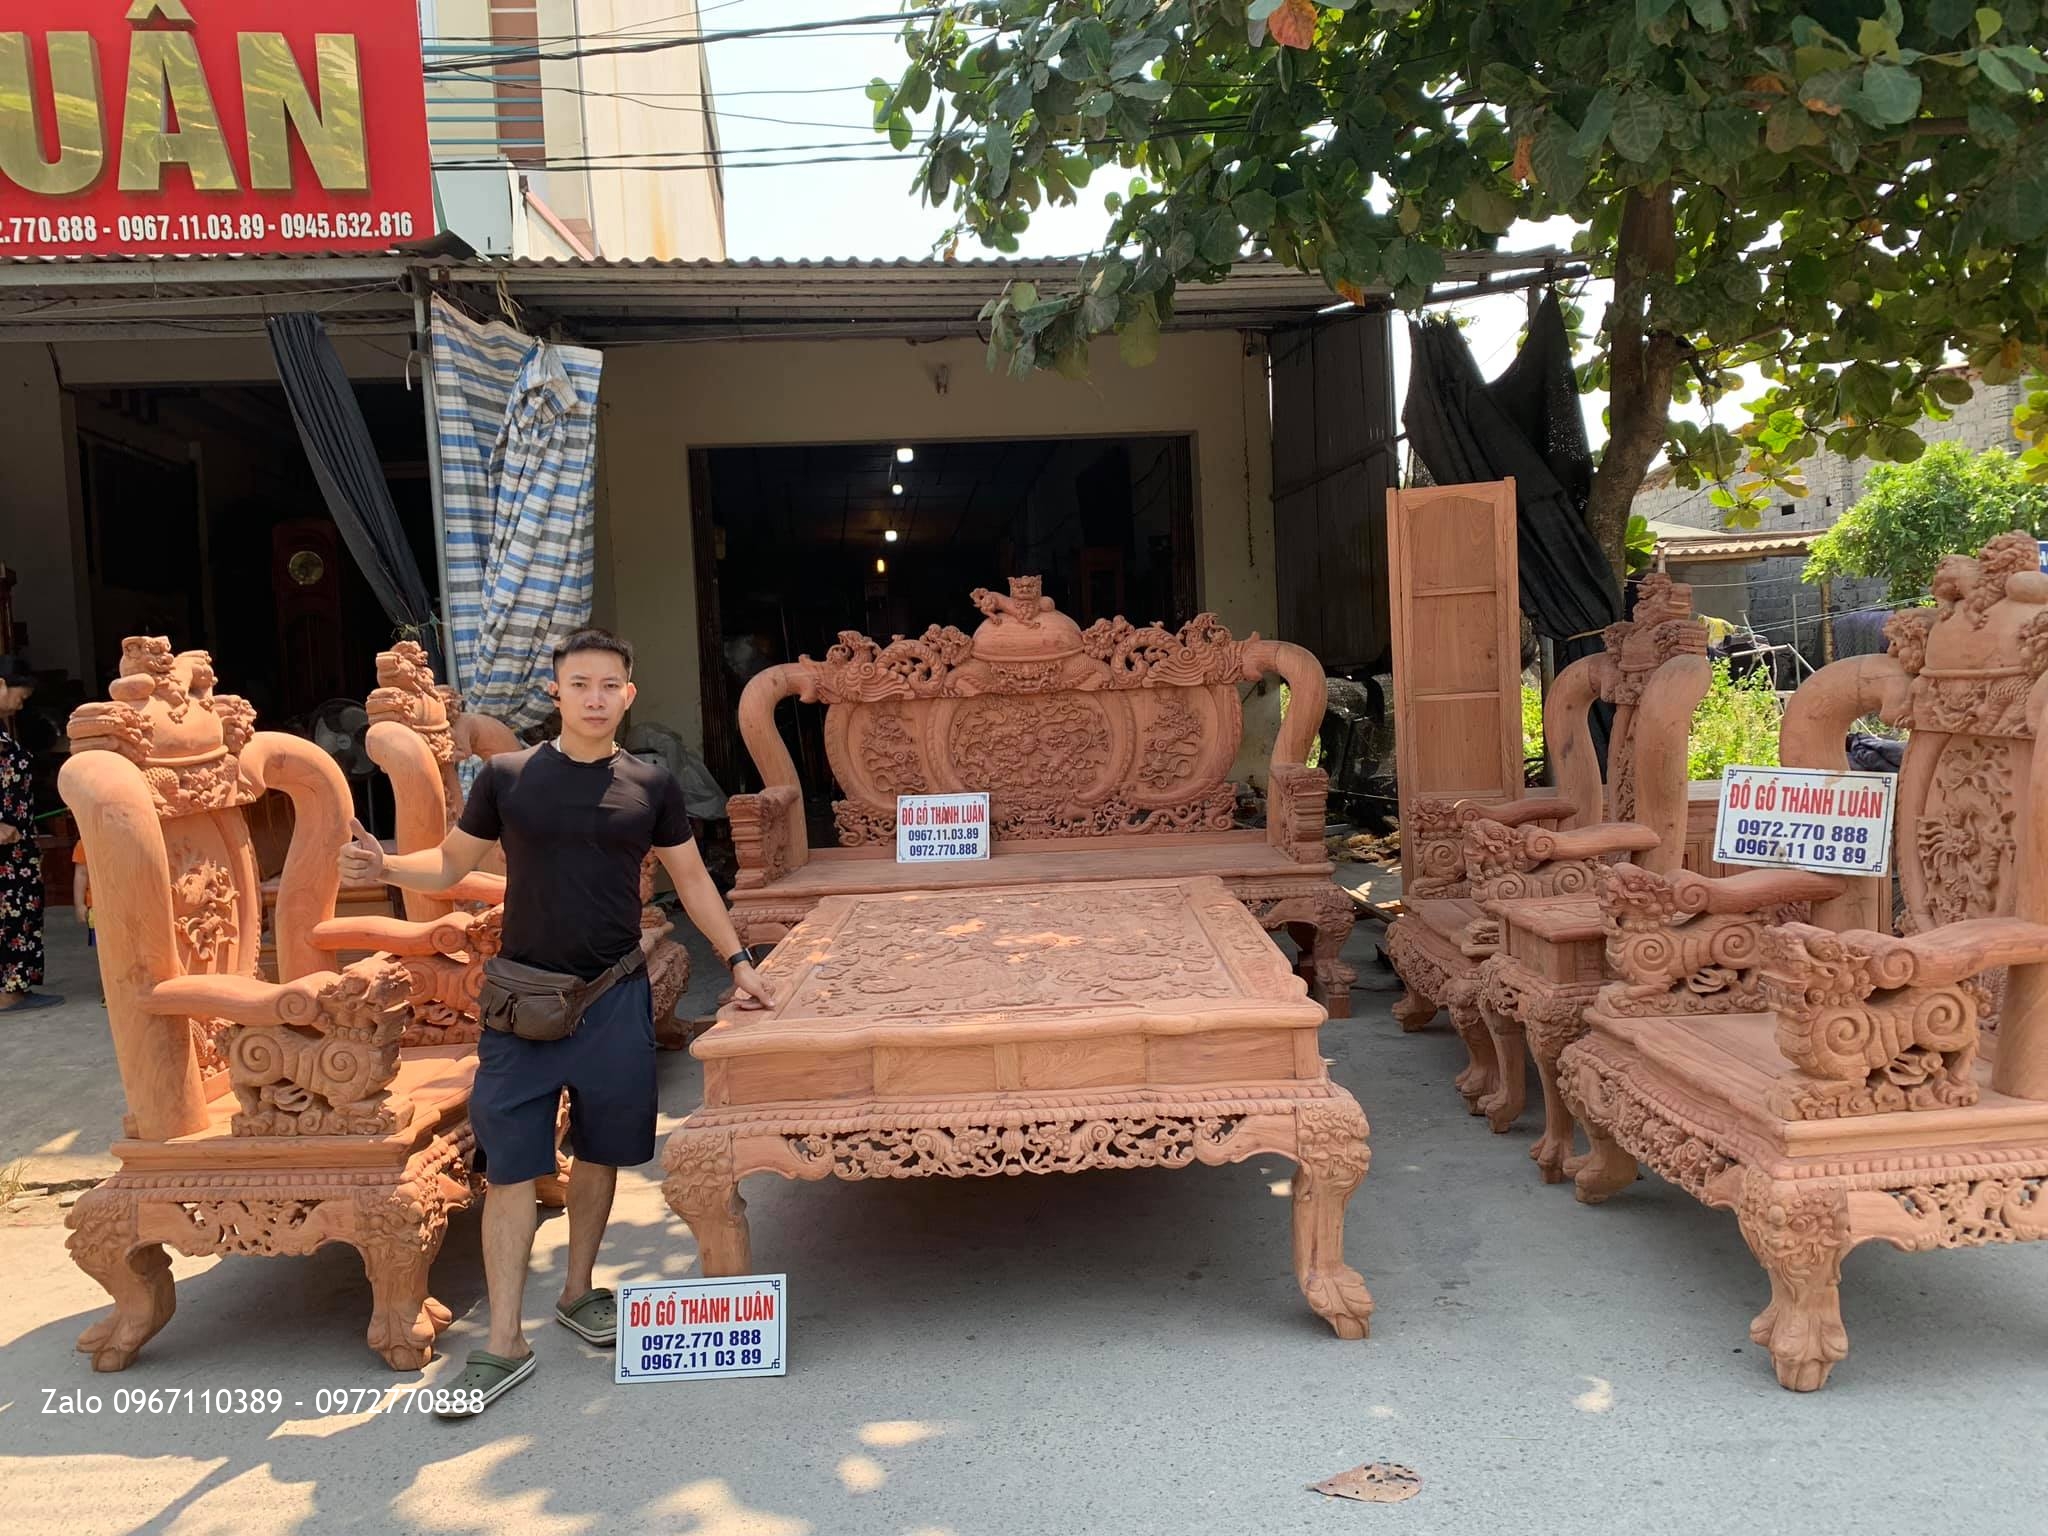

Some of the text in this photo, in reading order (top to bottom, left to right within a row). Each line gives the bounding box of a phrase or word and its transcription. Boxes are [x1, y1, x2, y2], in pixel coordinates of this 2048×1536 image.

[118, 213, 264, 242] 0967.11.03.89
[281, 212, 413, 239] 0945.632.816
[1755, 777, 1779, 811] GỖ
[1781, 783, 1834, 815] THÀNH
[1838, 786, 1883, 818] LUÂN
[931, 802, 959, 824] THÀNH
[962, 801, 984, 823] LUÂN
[908, 828, 979, 841] 0967.11.03.89
[1737, 819, 1868, 843] 0972.770 888
[910, 843, 977, 856] 0972.770.888
[1813, 844, 1836, 861] 03
[1842, 847, 1866, 864] 89
[656, 1291, 677, 1325] GỖ
[681, 1293, 730, 1324] THÀNH
[735, 1290, 774, 1322] LUÂN
[642, 1329, 761, 1351] 0972.770 888
[641, 1349, 761, 1370] 0967.11 03 89
